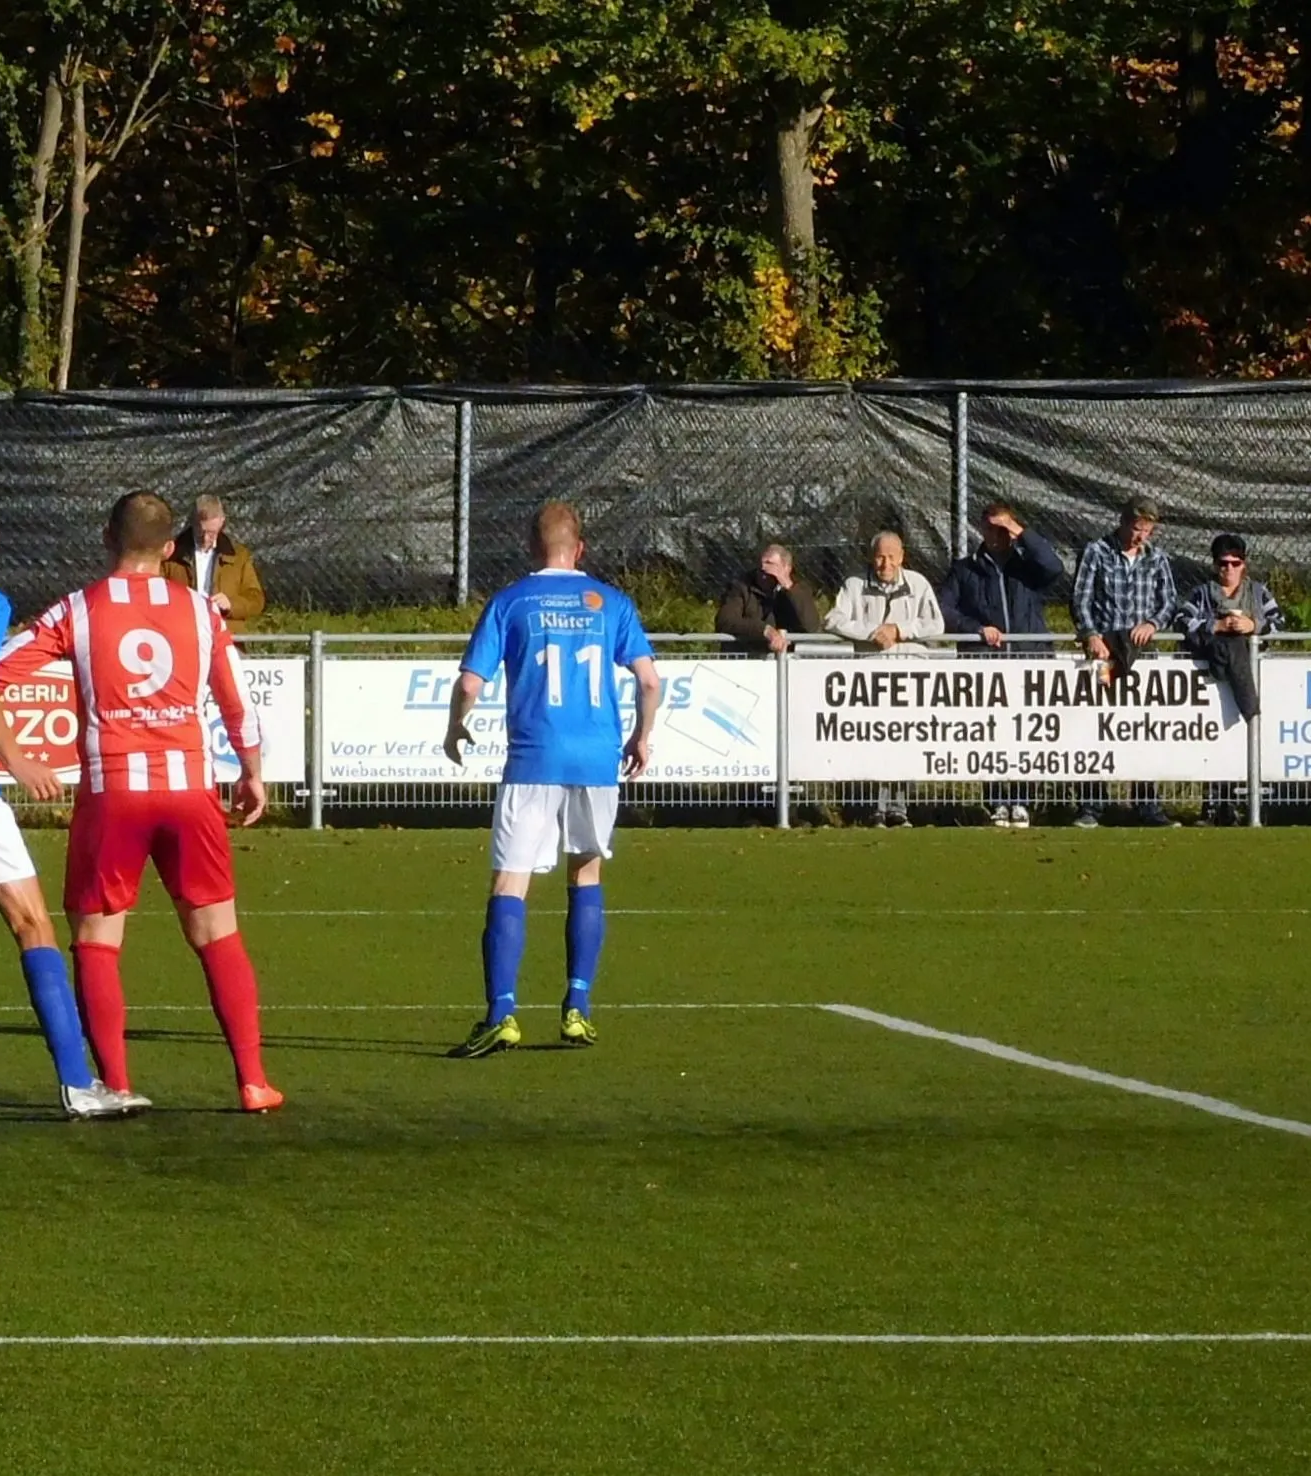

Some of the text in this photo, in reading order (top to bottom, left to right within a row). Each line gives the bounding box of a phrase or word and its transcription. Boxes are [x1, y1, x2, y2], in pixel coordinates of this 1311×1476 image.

[118, 628, 174, 699] 9
[535, 644, 602, 708] 11
[0, 684, 68, 703] GERIJ
[825, 670, 1210, 707] CAFETARIA HAANRADE
[2, 708, 79, 746] ZO
[816, 712, 1219, 742] Meuserstraat 129 Kerkrade
[331, 741, 377, 755] Voor
[385, 740, 426, 755] Verf
[923, 750, 1115, 774] Tel: 045-5461824
[330, 765, 445, 777] Wiebachstraat
[665, 765, 770, 777] 045-5419136
